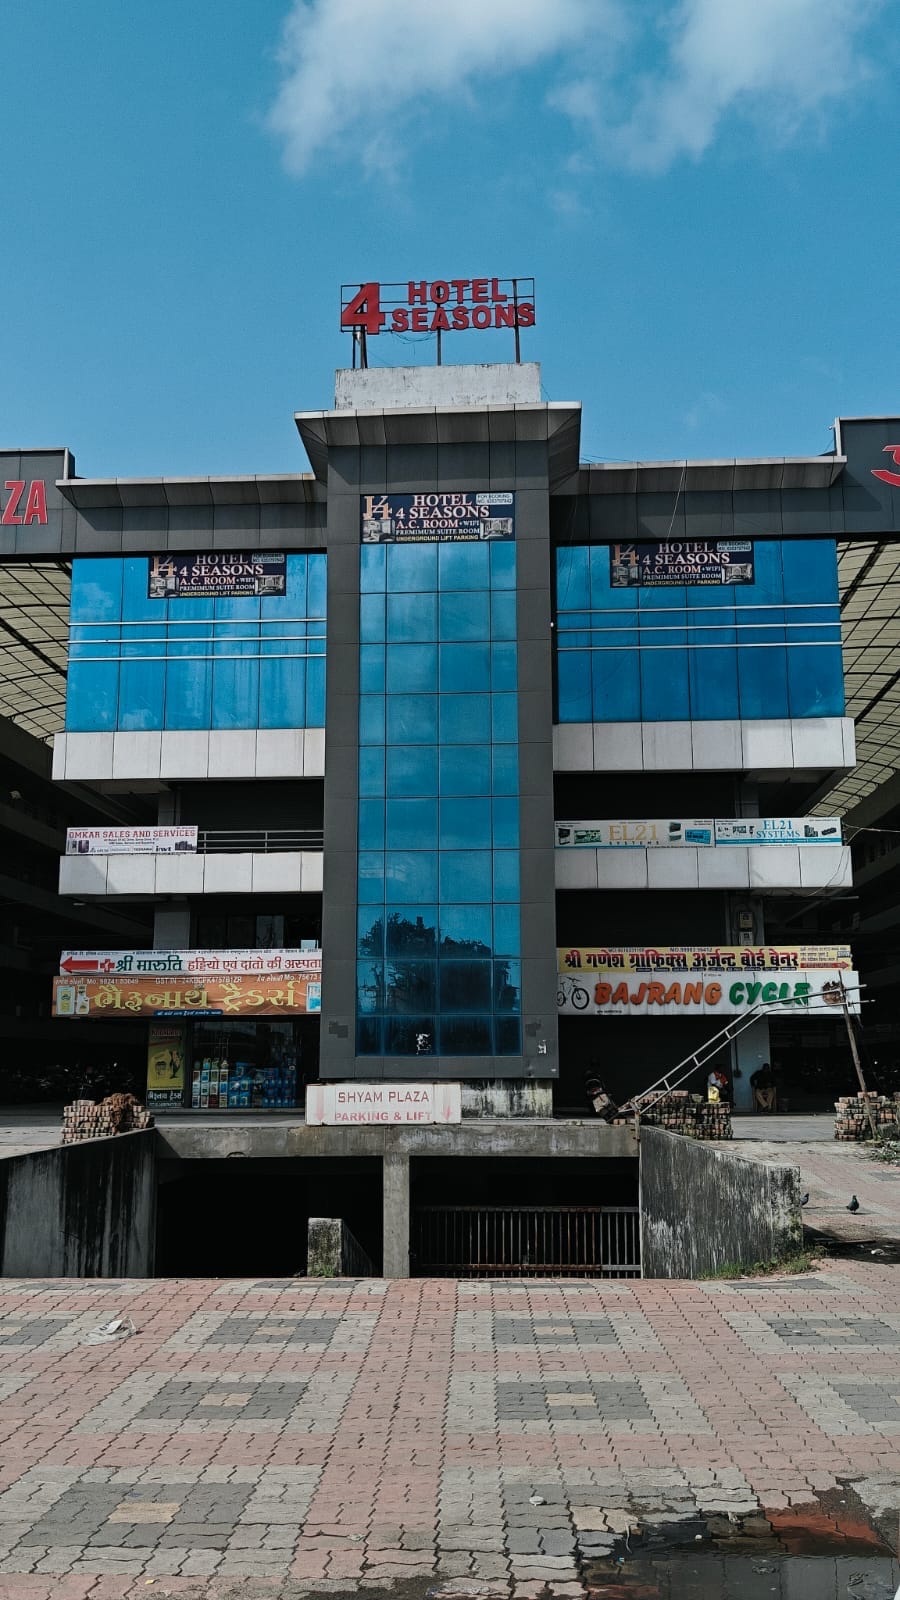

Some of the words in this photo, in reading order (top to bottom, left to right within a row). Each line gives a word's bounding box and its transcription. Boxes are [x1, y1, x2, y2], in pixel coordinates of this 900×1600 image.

[408, 278, 507, 305] HOTEL
[341, 282, 385, 334] 4
[391, 303, 535, 332] SEASONS
[413, 494, 472, 506] HOTEL
[396, 507, 406, 518] 4
[409, 505, 490, 519] SEASONS
[396, 519, 420, 529] A.C.
[423, 519, 459, 528] ROOM
[659, 542, 713, 553] HOTEL
[196, 554, 249, 565] HOTEL
[643, 555, 652, 565] 4
[655, 553, 730, 565] SEASONS
[180, 566, 188, 577] 4
[192, 564, 264, 576] SEASONS
[643, 566, 665, 574] A.C.
[668, 565, 701, 574] ROOM
[180, 577, 201, 585] A.C.
[204, 576, 236, 585] ROOM
[764, 820, 793, 830] EL21
[69, 831, 100, 839] OMKAR
[102, 830, 130, 838] SALES
[153, 829, 196, 837] SERVICES
[609, 824, 658, 841] EL21
[756, 830, 801, 839] SYSTEMS
[116, 955, 134, 972] श्री
[267, 955, 282, 969] की
[565, 949, 582, 968] श्री
[586, 949, 625, 968] गणेश
[740, 948, 766, 967] बोर्ड
[769, 948, 799, 966] बेनर
[594, 981, 722, 1005] BAJRANG
[729, 981, 811, 1005] CYCLE
[338, 1091, 383, 1103] SHYAM
[388, 1091, 430, 1103] PLAZA
[335, 1111, 389, 1121] PARKING
[394, 1112, 402, 1121] &
[407, 1111, 432, 1121] LIFT
